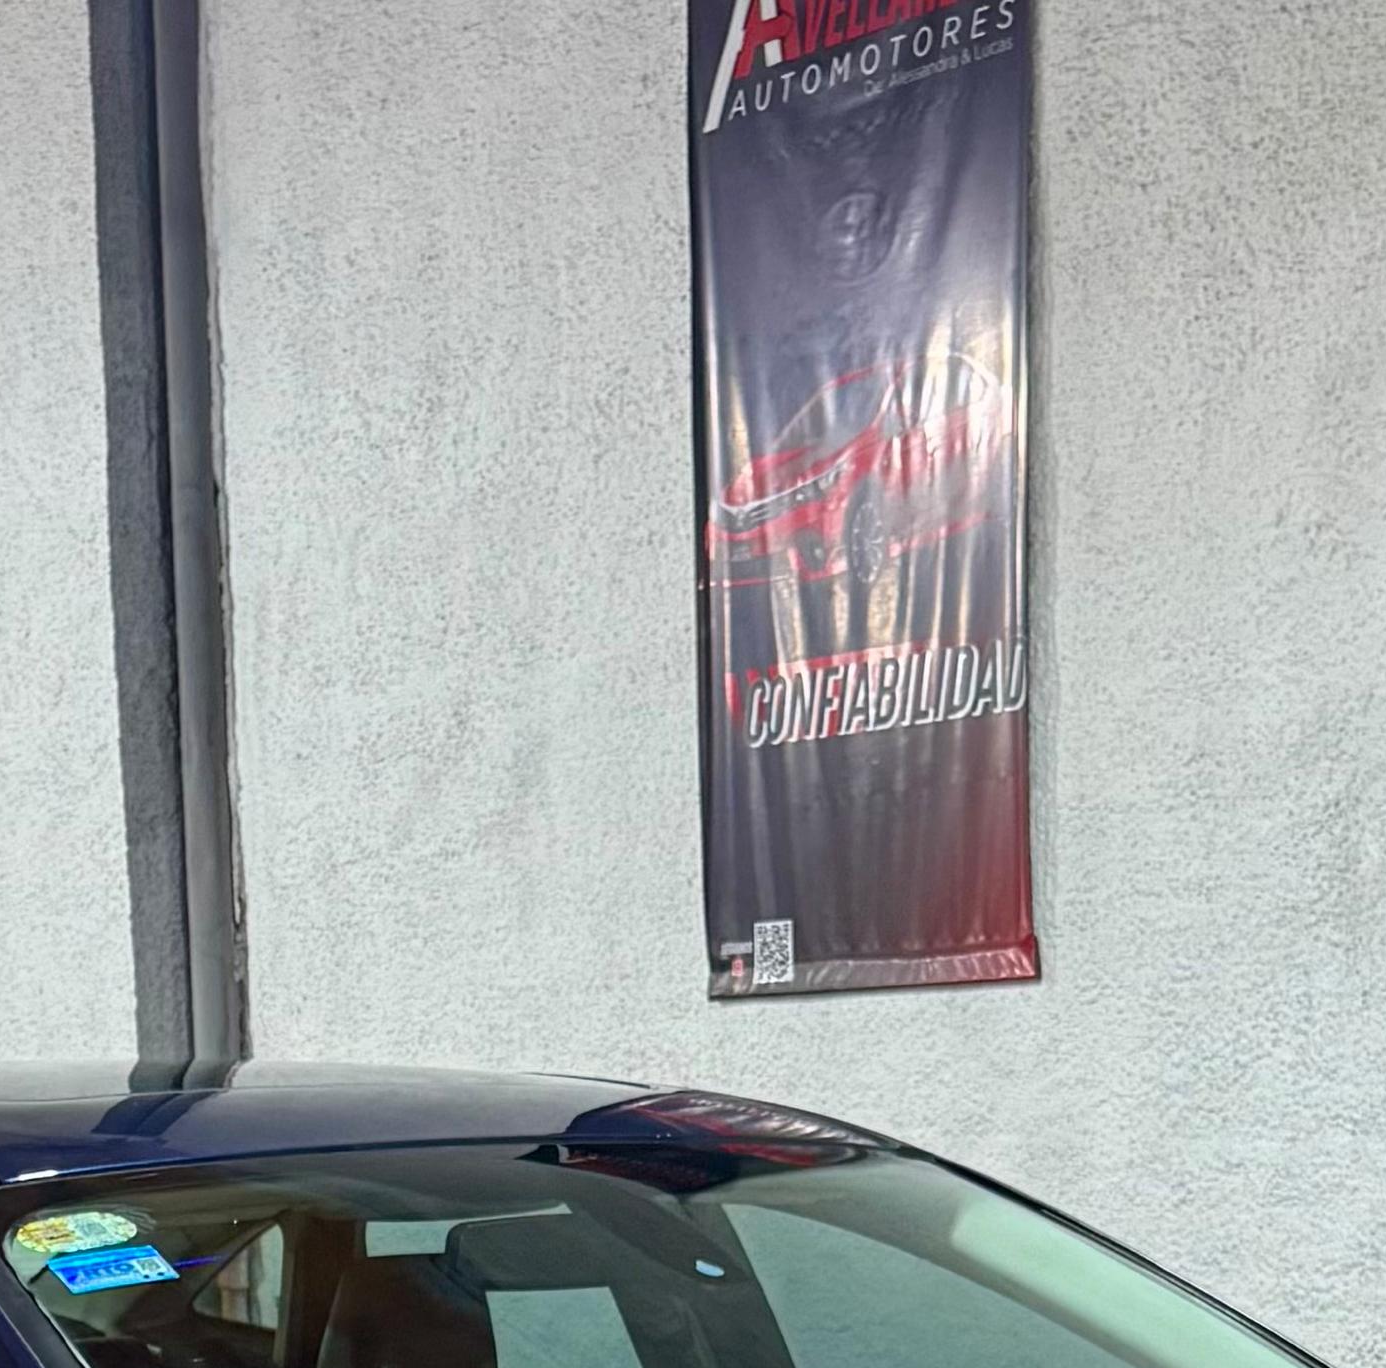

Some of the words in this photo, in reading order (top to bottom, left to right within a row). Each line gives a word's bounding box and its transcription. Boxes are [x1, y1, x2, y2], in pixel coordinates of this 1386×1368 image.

[728, 0, 1013, 120] AUTOMOTORES
[973, 37, 1013, 60] Lucas
[747, 637, 1027, 748] CONFIABILIDAD
